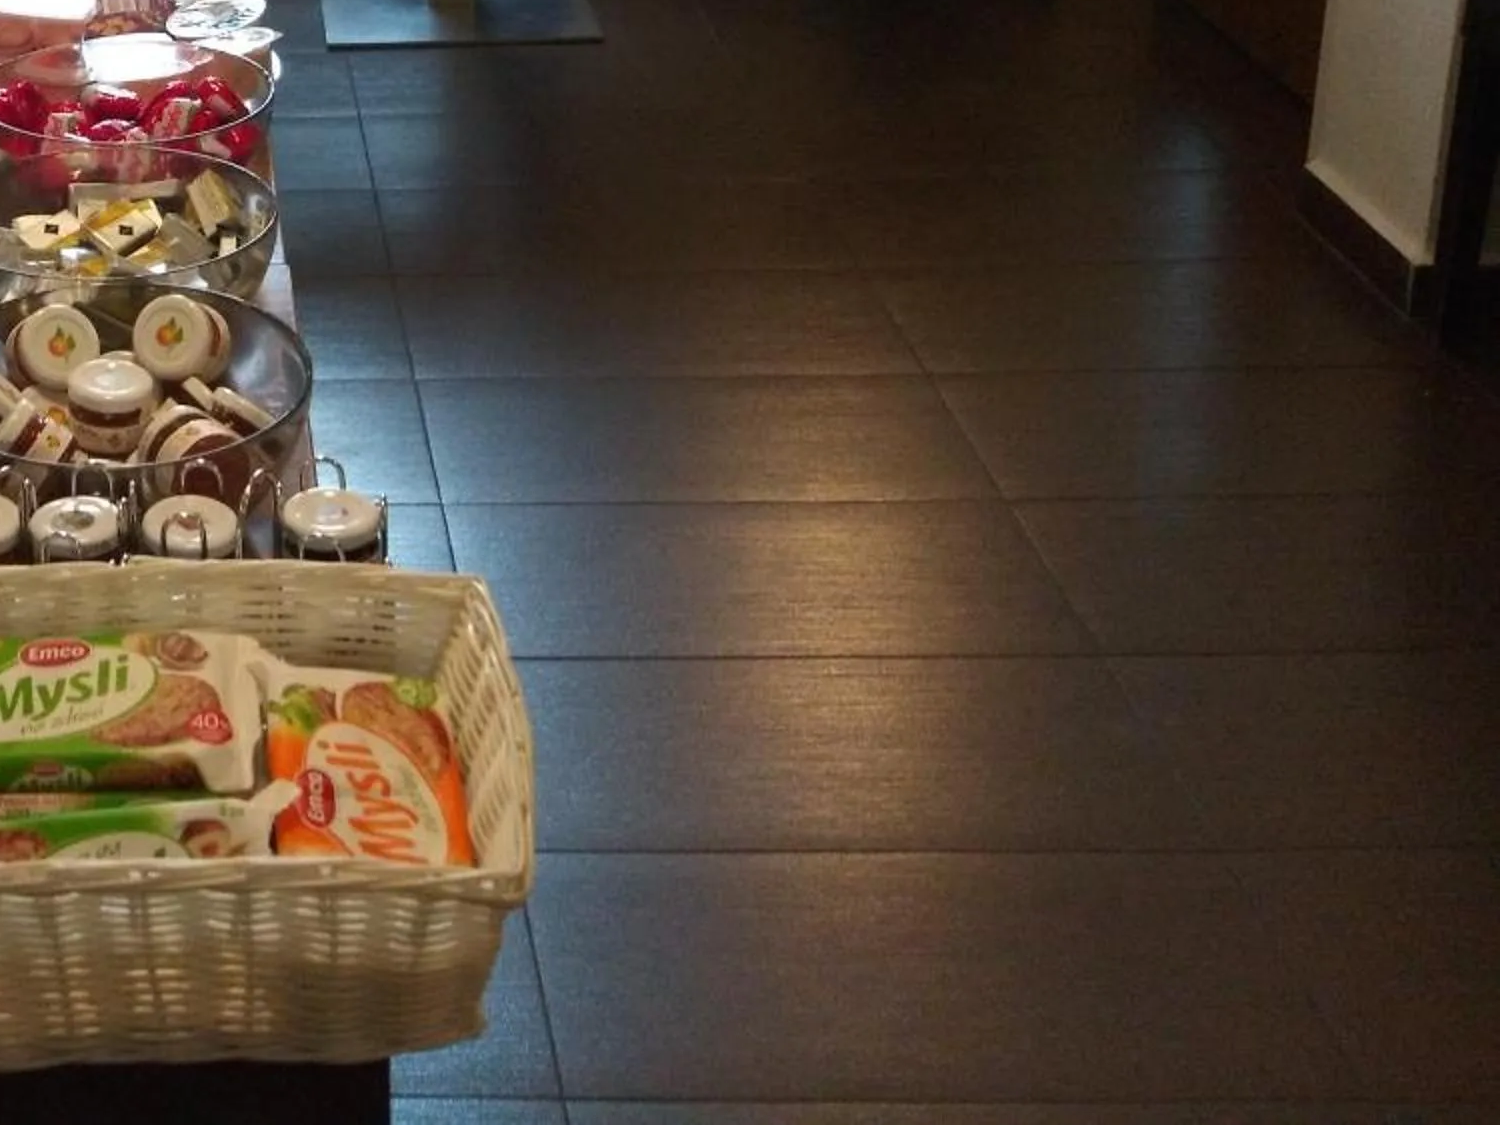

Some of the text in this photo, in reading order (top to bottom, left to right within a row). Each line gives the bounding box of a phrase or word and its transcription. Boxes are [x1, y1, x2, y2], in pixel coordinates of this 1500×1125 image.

[27, 644, 87, 662] Emco
[306, 771, 326, 823] Emco
[315, 739, 429, 865] Mysli
